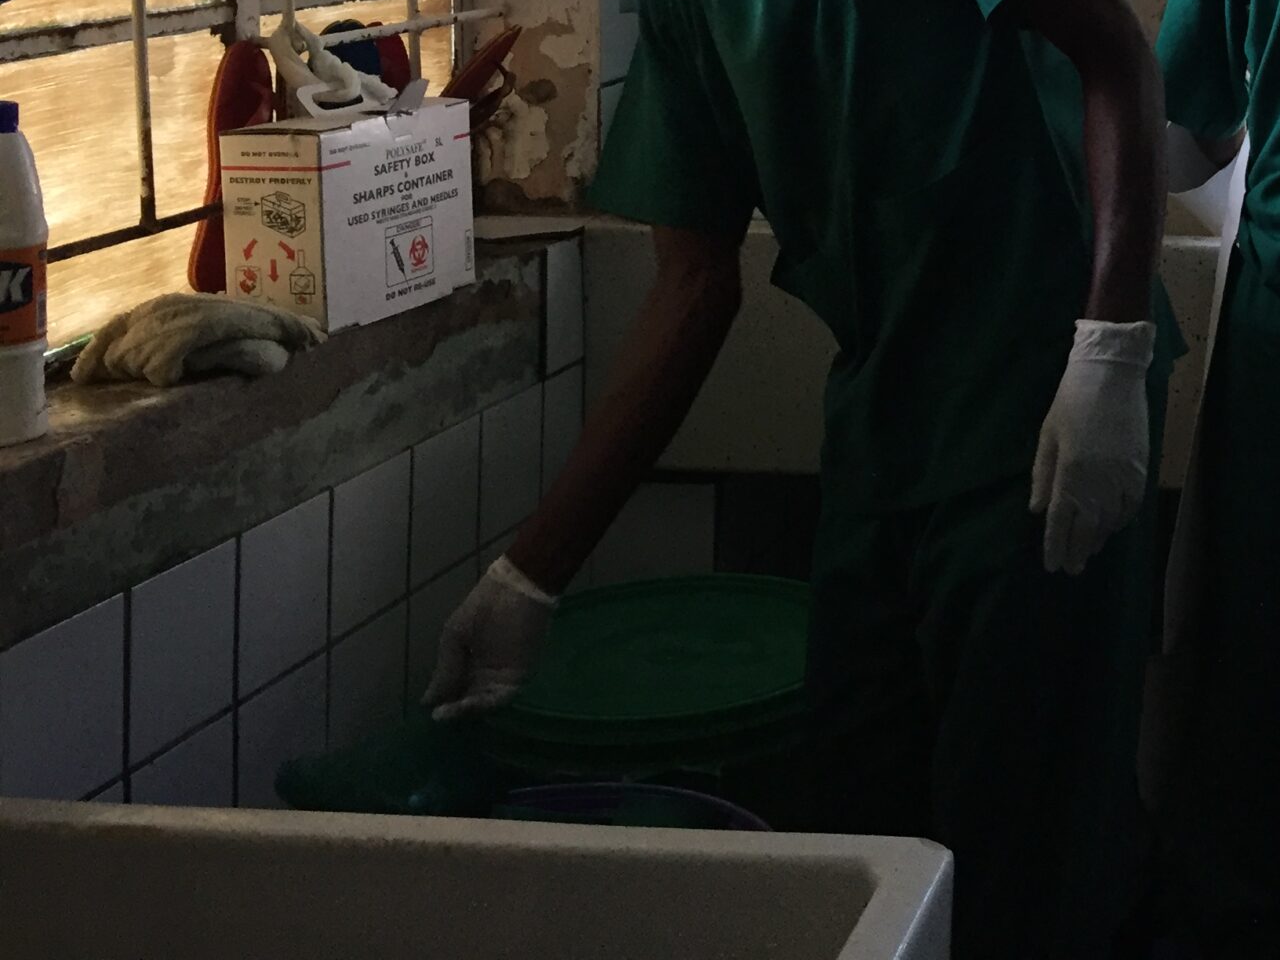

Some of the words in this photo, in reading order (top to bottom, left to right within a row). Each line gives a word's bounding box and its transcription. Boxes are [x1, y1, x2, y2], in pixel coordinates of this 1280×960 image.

[374, 158, 411, 176] SAFETY
[414, 152, 435, 166] BOX
[269, 177, 312, 185] PROPERLY
[353, 184, 395, 204] SHARPS
[397, 169, 454, 193] CONTAINER
[347, 212, 369, 226] USED
[371, 202, 410, 220] SYRINGES
[412, 197, 428, 209] AND
[430, 187, 458, 204] NEEDLES
[401, 193, 413, 201] FOR
[386, 292, 396, 301] DO
[398, 286, 412, 297] NOT
[414, 277, 436, 291] RE-USE
